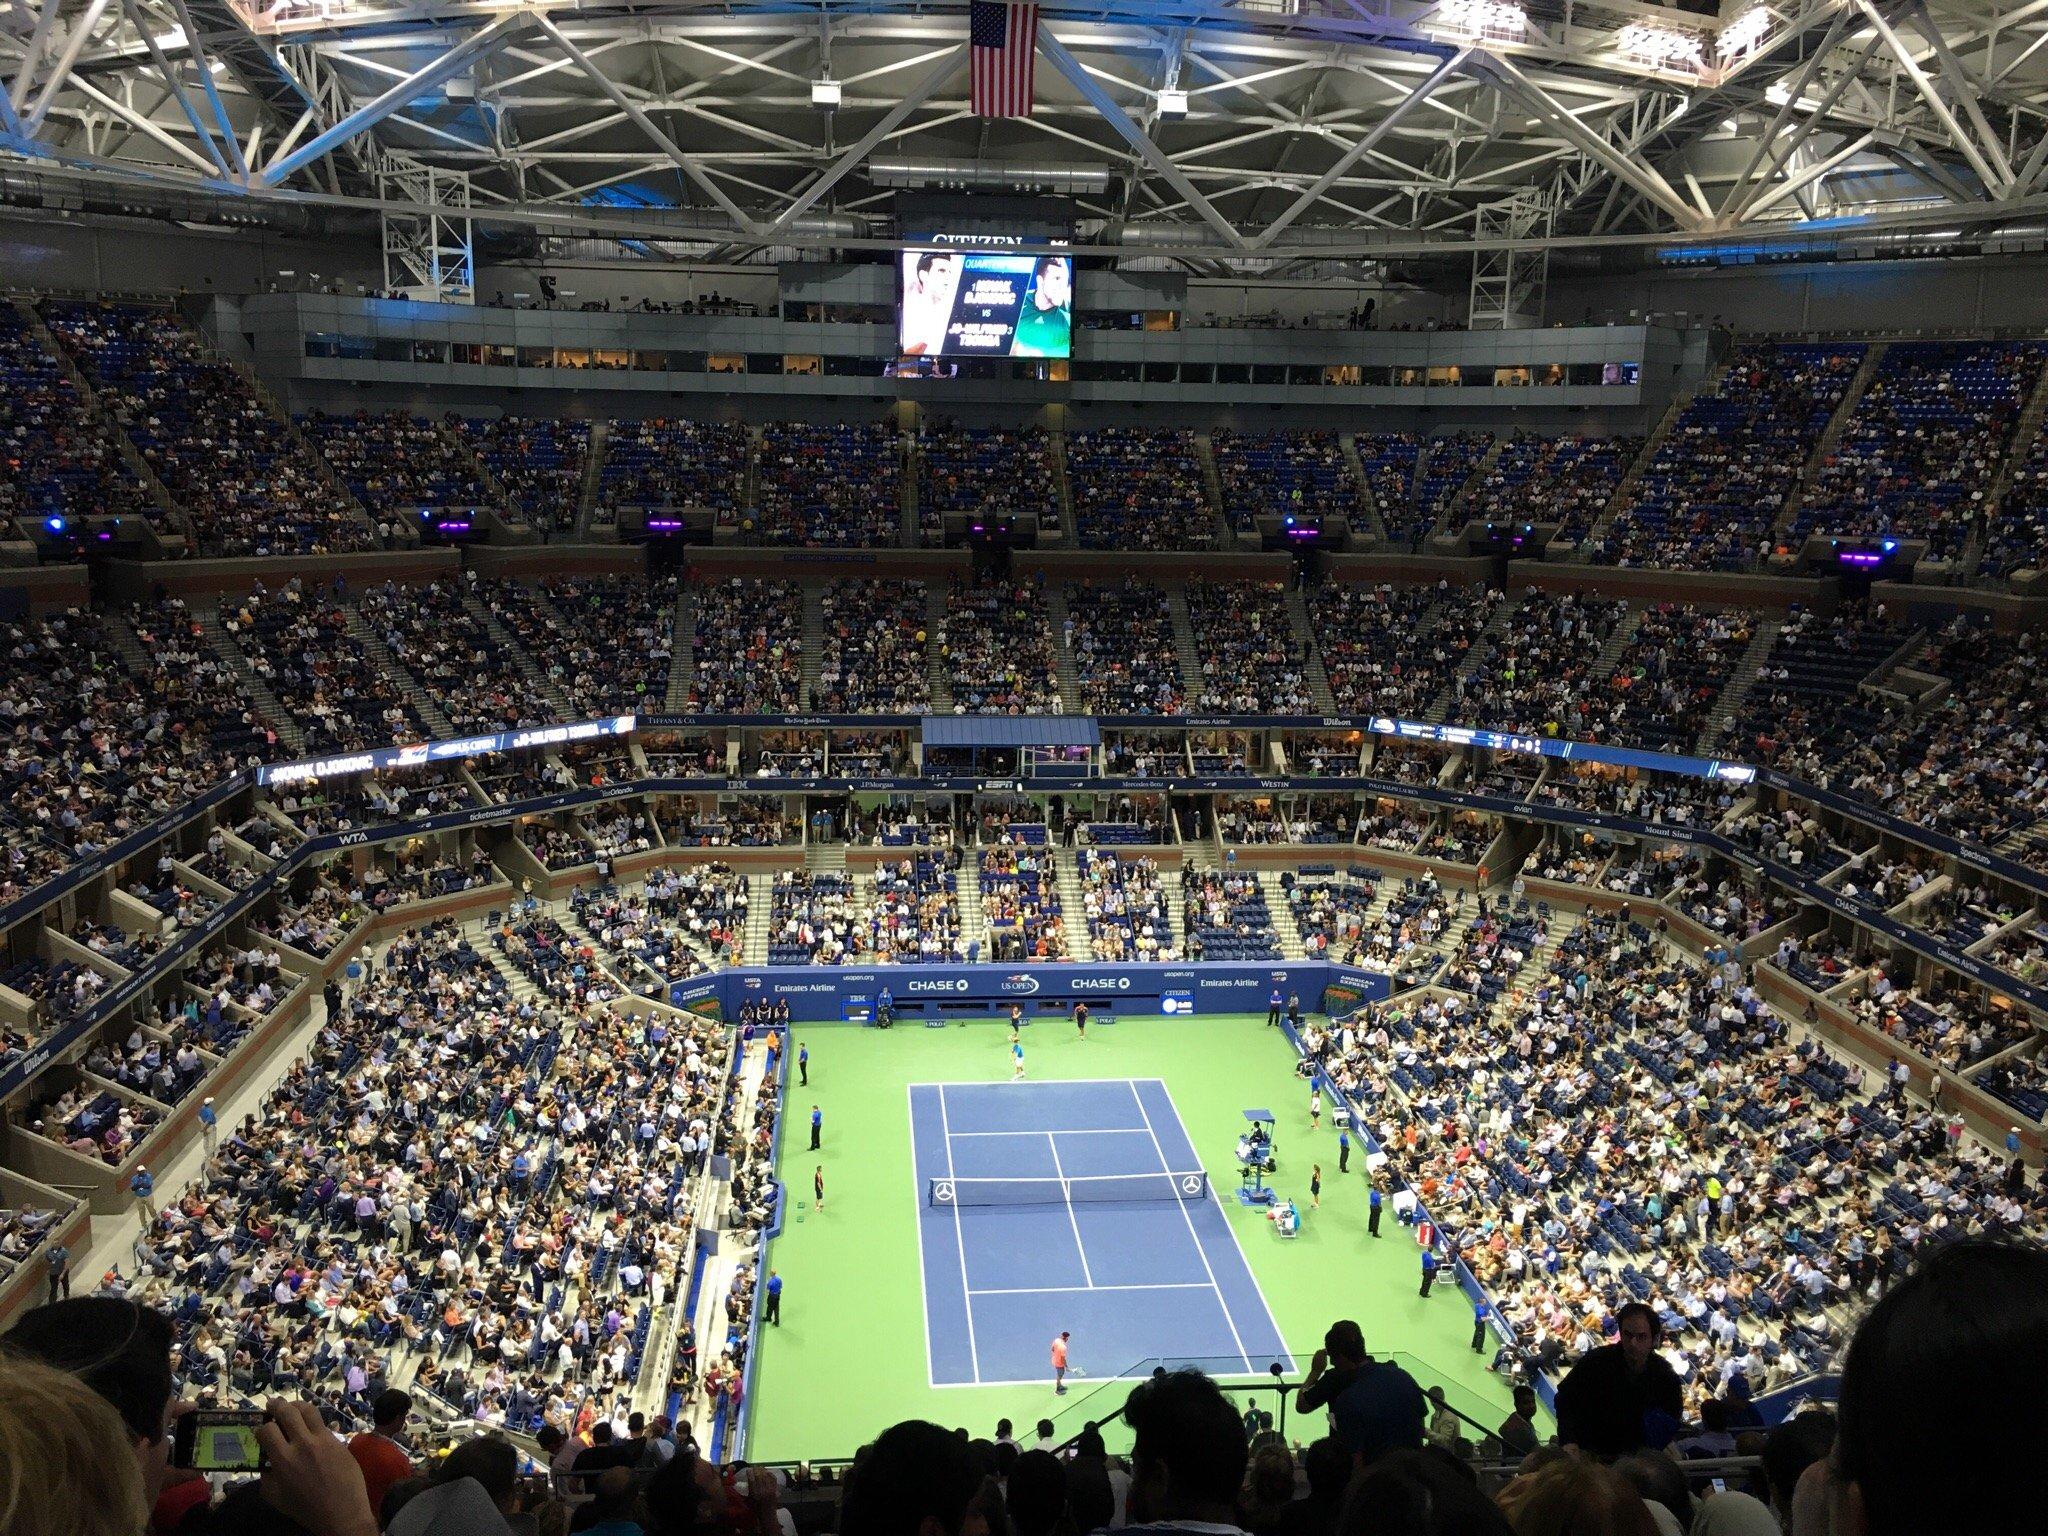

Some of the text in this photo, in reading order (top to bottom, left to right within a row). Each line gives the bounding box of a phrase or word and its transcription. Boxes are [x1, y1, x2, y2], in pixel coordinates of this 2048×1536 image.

[648, 717, 676, 725] TIFFANY
[1323, 717, 1351, 726] Wilson
[727, 781, 748, 789] IBM
[469, 808, 514, 821] ticketmaster
[1513, 805, 1532, 814] evian
[1645, 826, 1692, 840] Mount Sinai
[339, 832, 368, 845] WTA
[1835, 898, 1859, 916] CHASE
[1071, 979, 1116, 989] CHASE
[1200, 979, 1233, 987] Emirates
[1340, 975, 1375, 986] AMERICAN
[1340, 979, 1368, 989] EXPRESS
[682, 984, 715, 996] AMERICAN
[809, 984, 835, 992] Airline
[908, 981, 954, 991] CHASE
[1001, 982, 1034, 990] US OPEN
[683, 990, 710, 1000] EXPRESS
